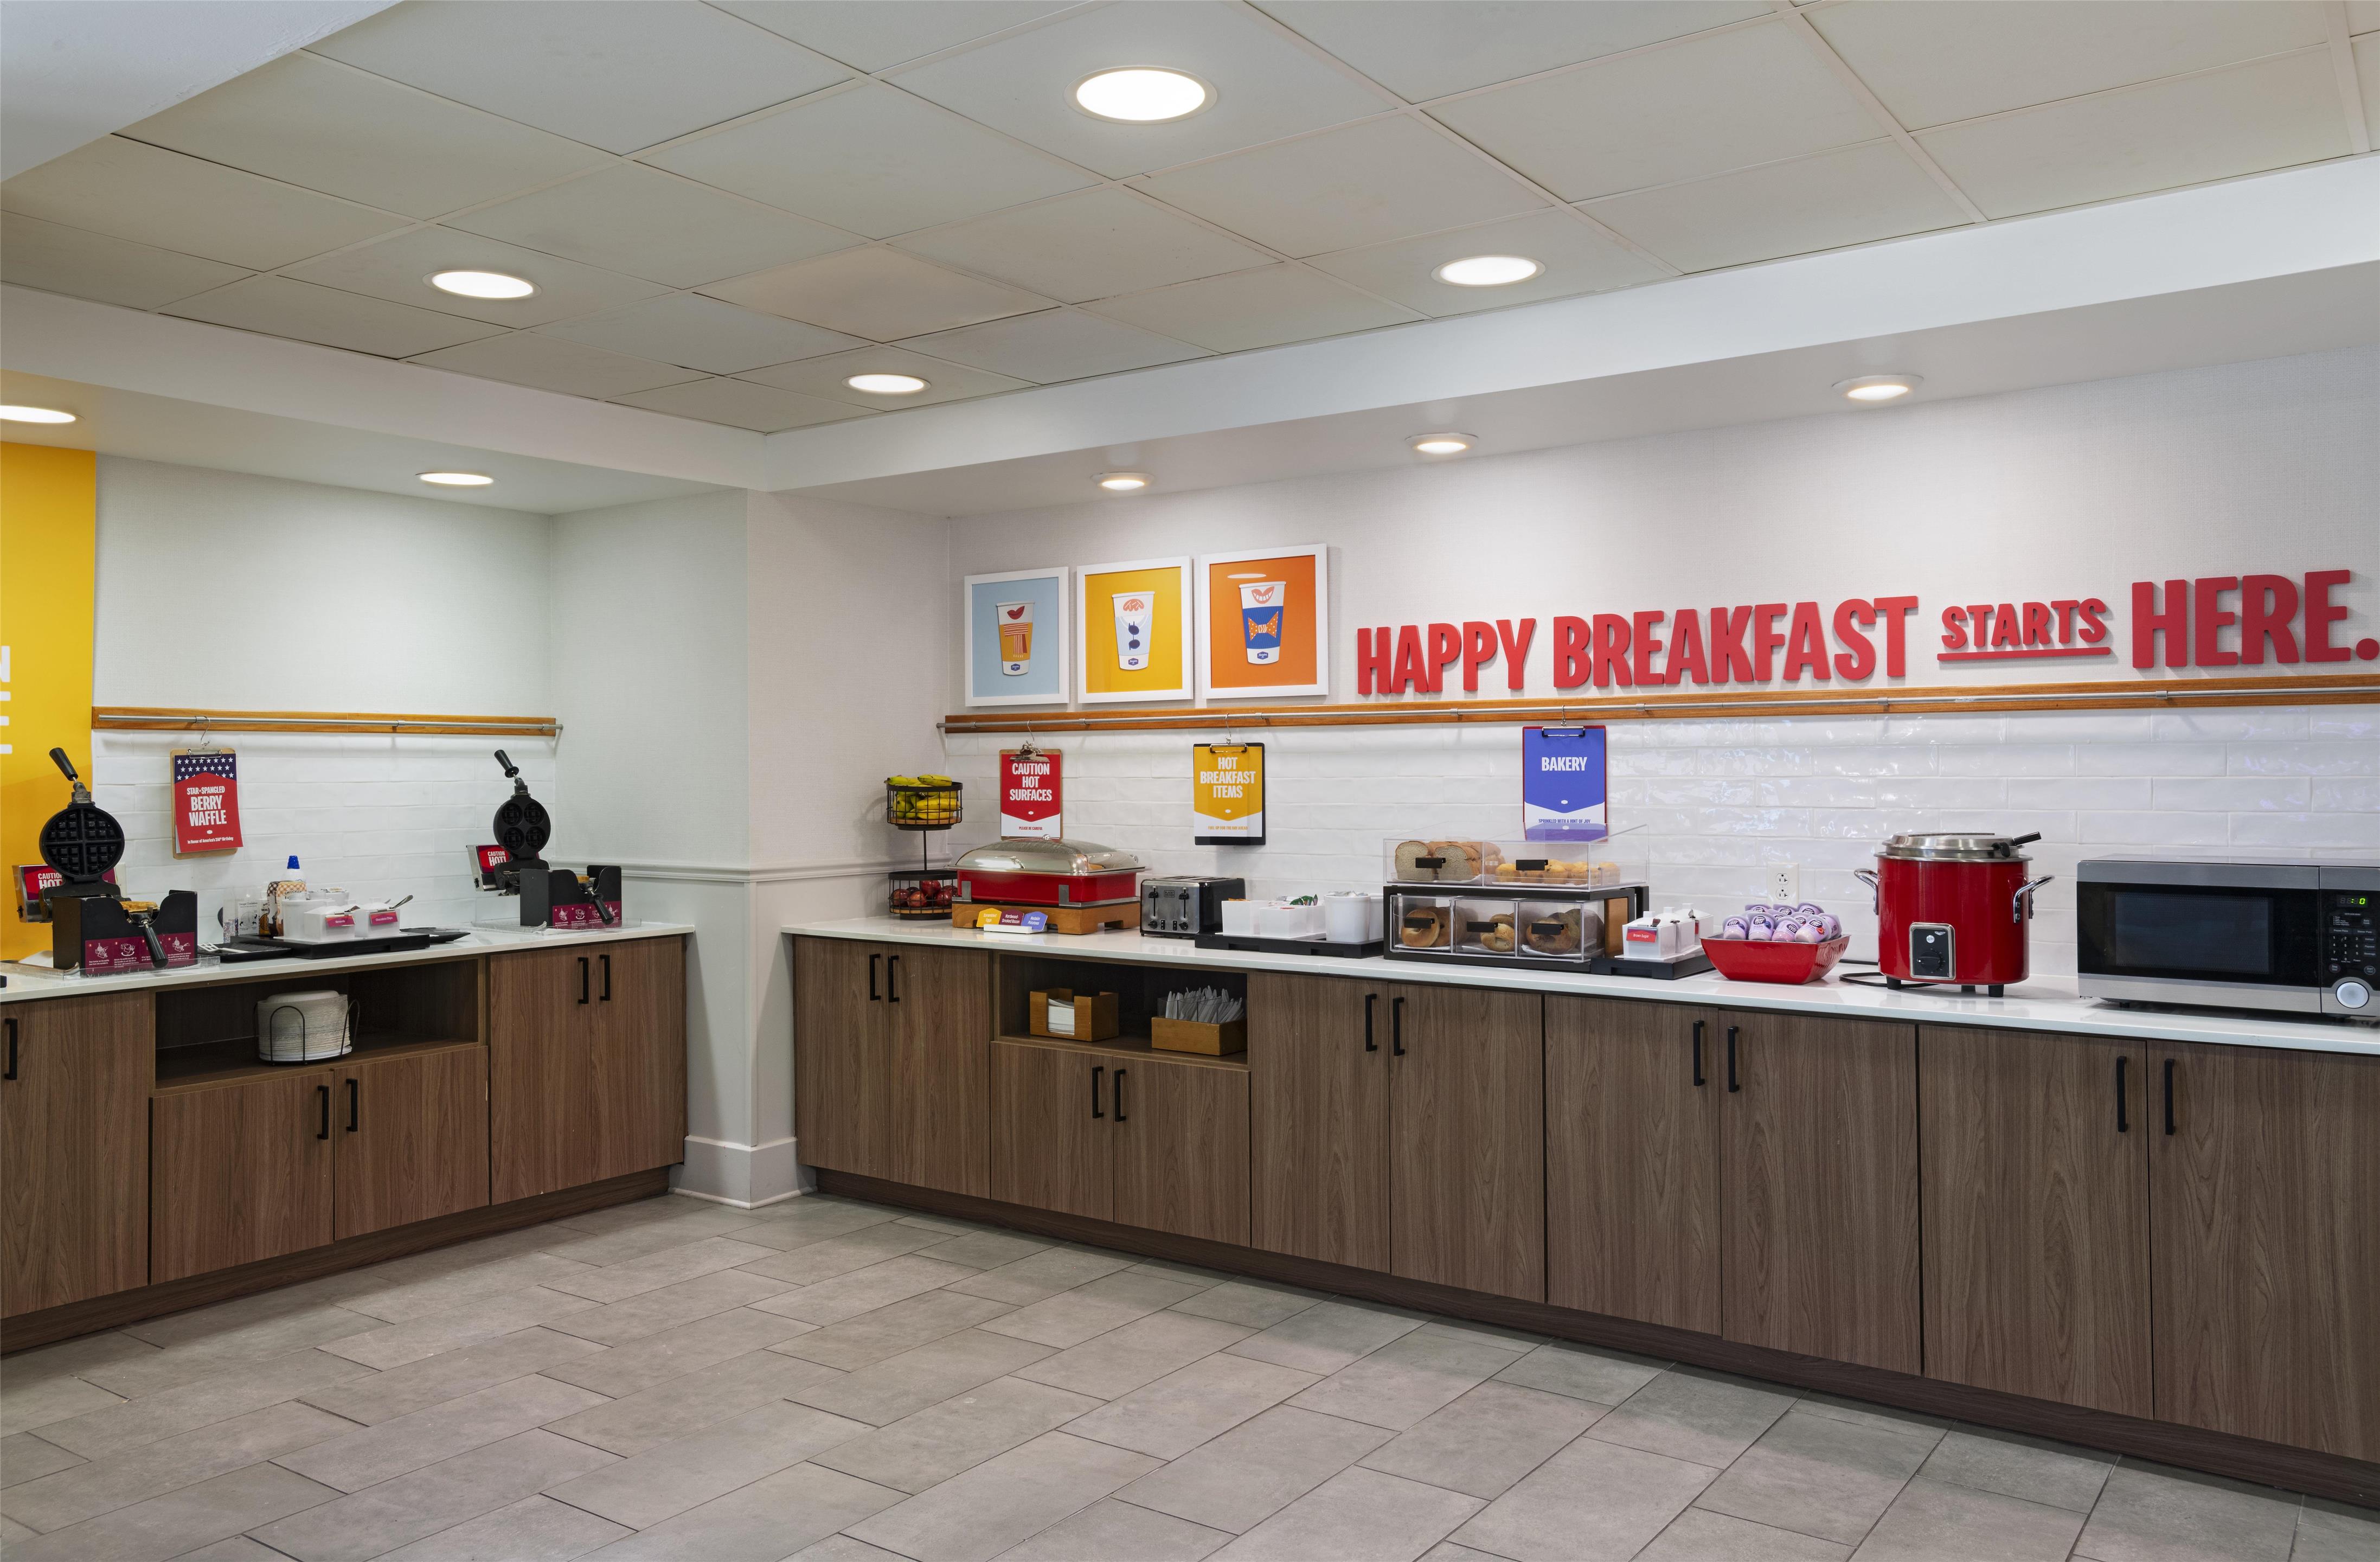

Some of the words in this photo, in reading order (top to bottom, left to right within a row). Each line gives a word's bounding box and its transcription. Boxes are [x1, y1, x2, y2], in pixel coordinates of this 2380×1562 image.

[1357, 618, 1536, 695] HAPPY
[1553, 596, 1918, 688] BREAKFAST
[1941, 598, 2106, 649] STARTS
[2132, 569, 2379, 668] HERE.
[1012, 763, 1050, 775] CAUTION
[1218, 757, 1238, 770] HOT
[1541, 757, 1588, 771] BAKERY
[1022, 776, 1040, 788] HOT
[1199, 771, 1256, 784] BREAKFAST
[201, 786, 225, 794] SPANGLED
[1010, 789, 1053, 801] SURFACES
[1213, 785, 1243, 798] ITEMS
[190, 795, 222, 811] BERRY
[189, 810, 227, 827] WAFFLE
